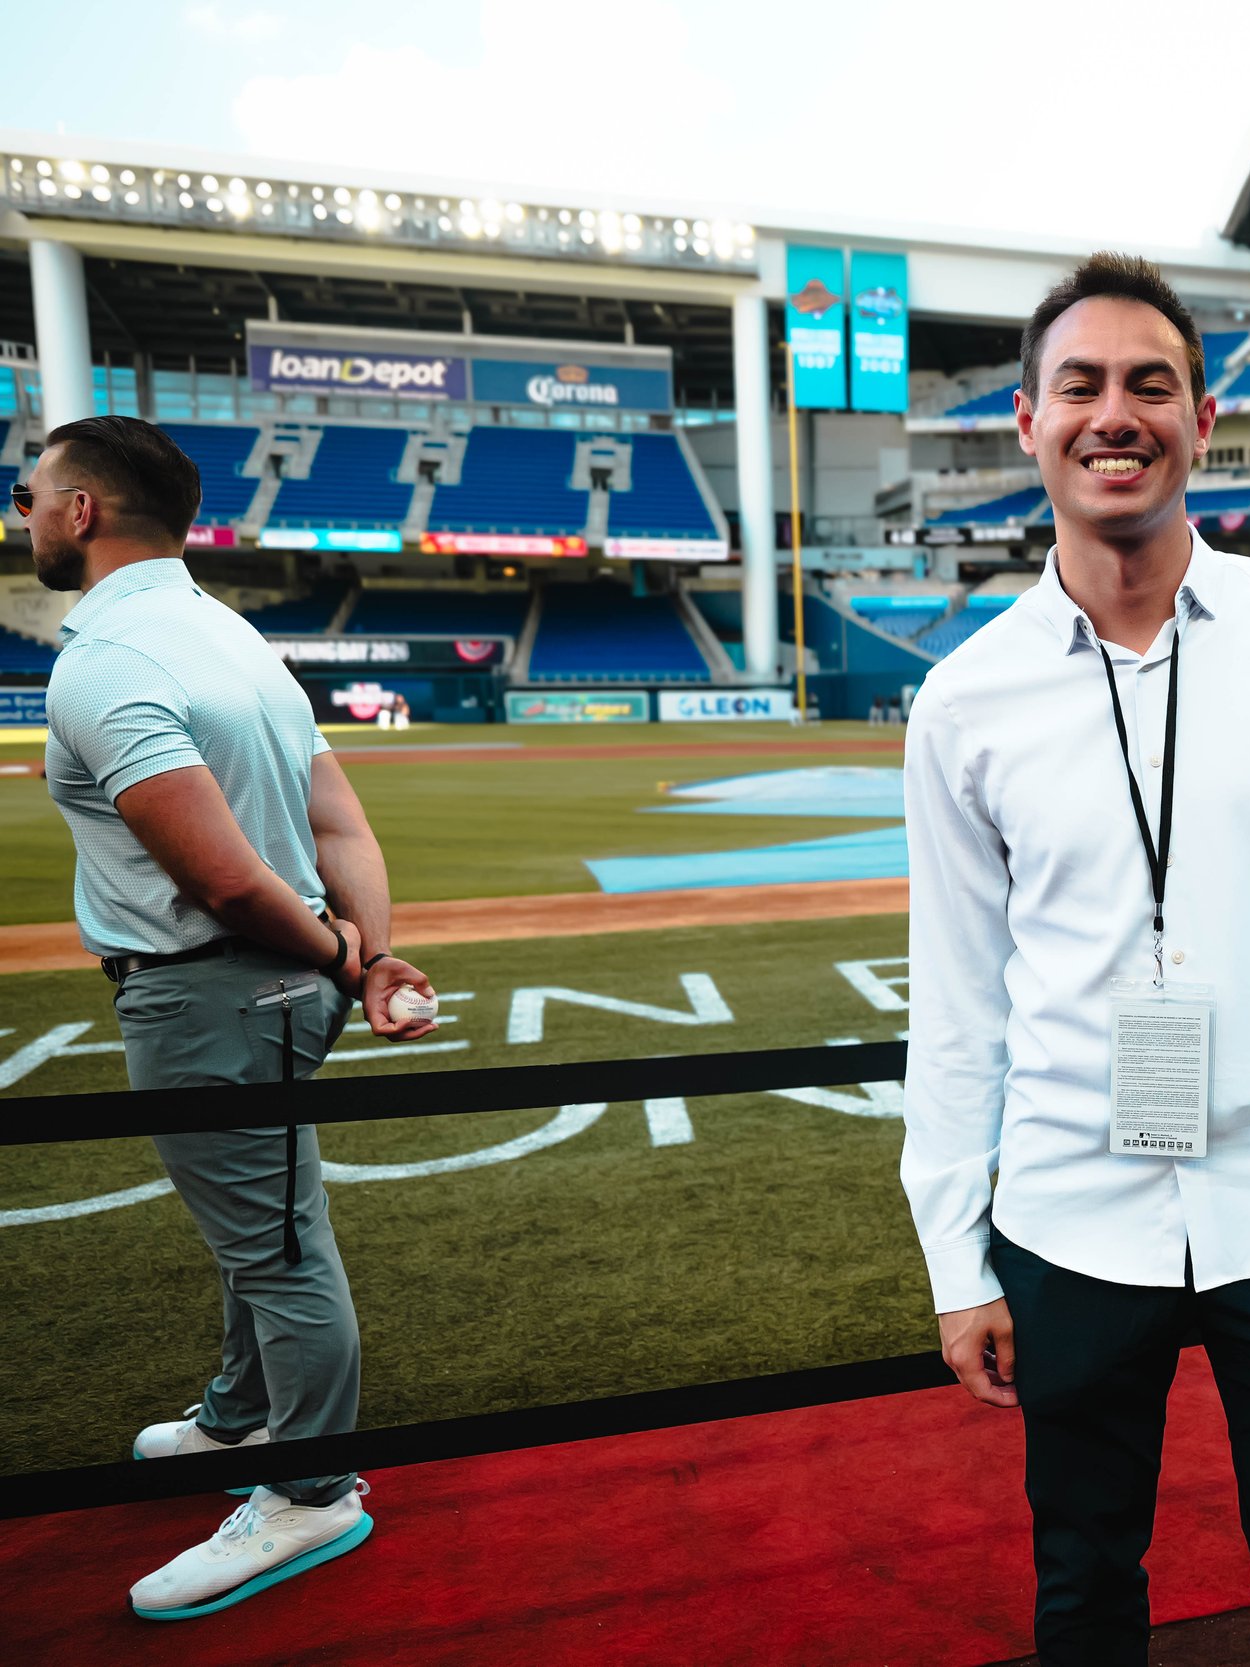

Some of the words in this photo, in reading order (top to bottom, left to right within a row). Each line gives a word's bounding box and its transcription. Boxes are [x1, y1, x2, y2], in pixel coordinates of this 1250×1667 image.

[270, 350, 447, 388] loanDepot
[527, 376, 618, 407] Corona
[701, 697, 770, 716] LEON
